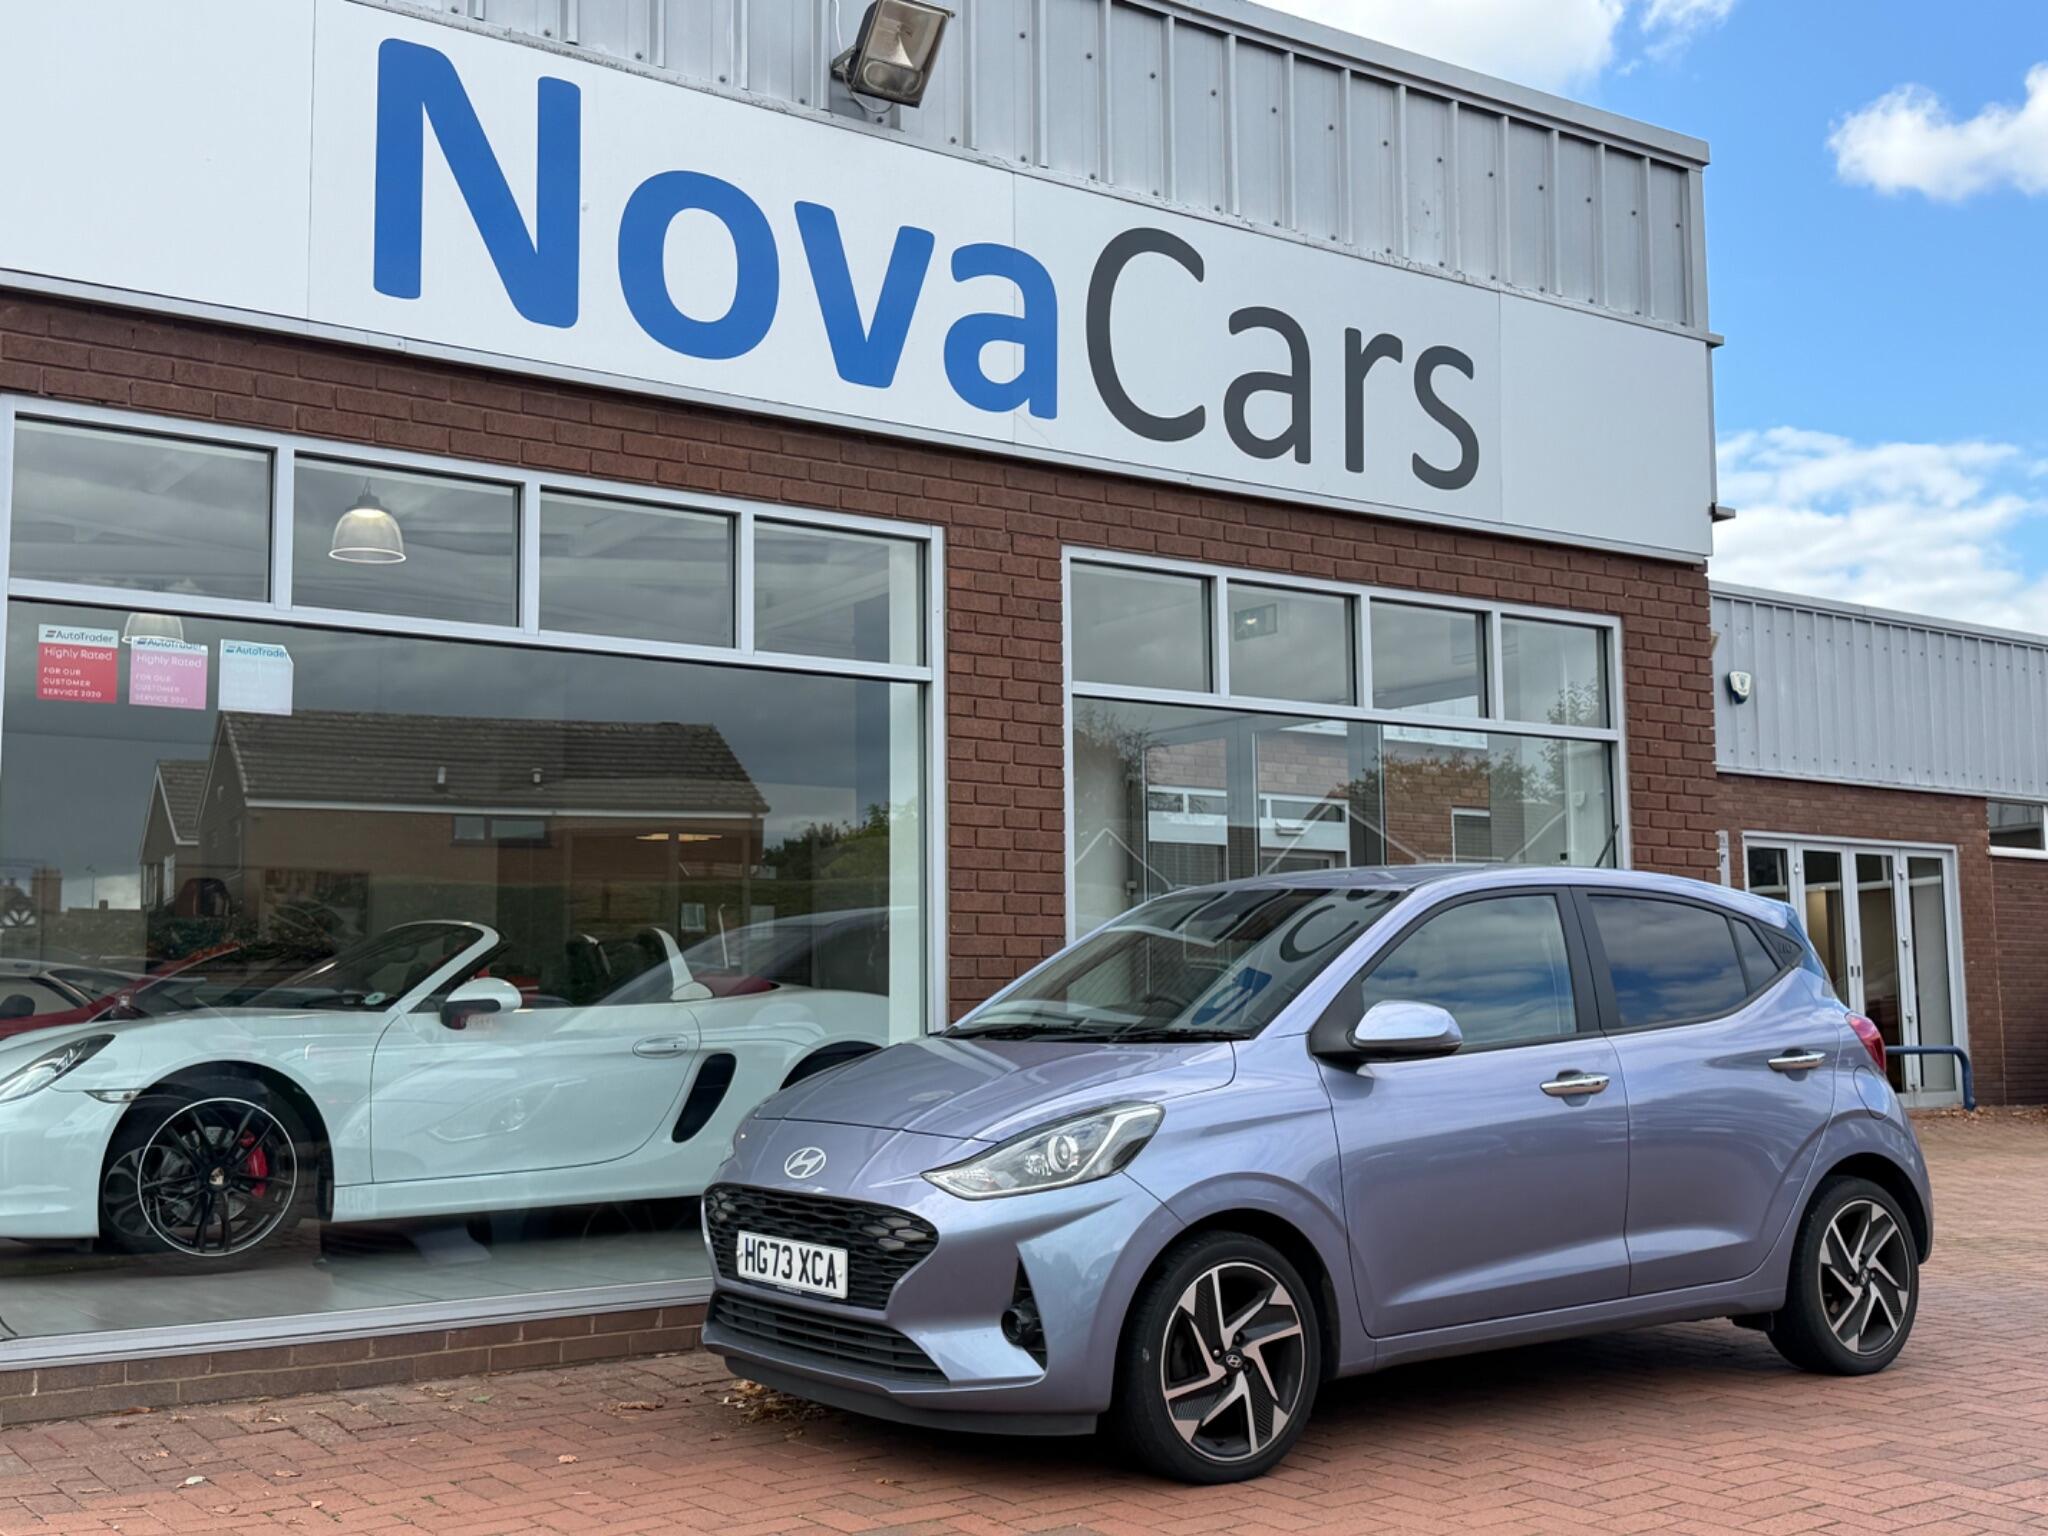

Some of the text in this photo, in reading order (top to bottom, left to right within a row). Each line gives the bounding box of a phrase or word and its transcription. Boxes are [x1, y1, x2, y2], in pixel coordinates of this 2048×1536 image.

[373, 38, 1480, 490] NovaCars
[56, 630, 114, 643] AutoTrader
[44, 647, 113, 661] Highly Rated
[136, 655, 202, 668] Highly Rated
[43, 667, 81, 676] FOR OUR
[43, 677, 91, 687] CUSTOMER
[43, 687, 79, 697] SERVICE
[745, 1238, 837, 1289] HG73 XCA
